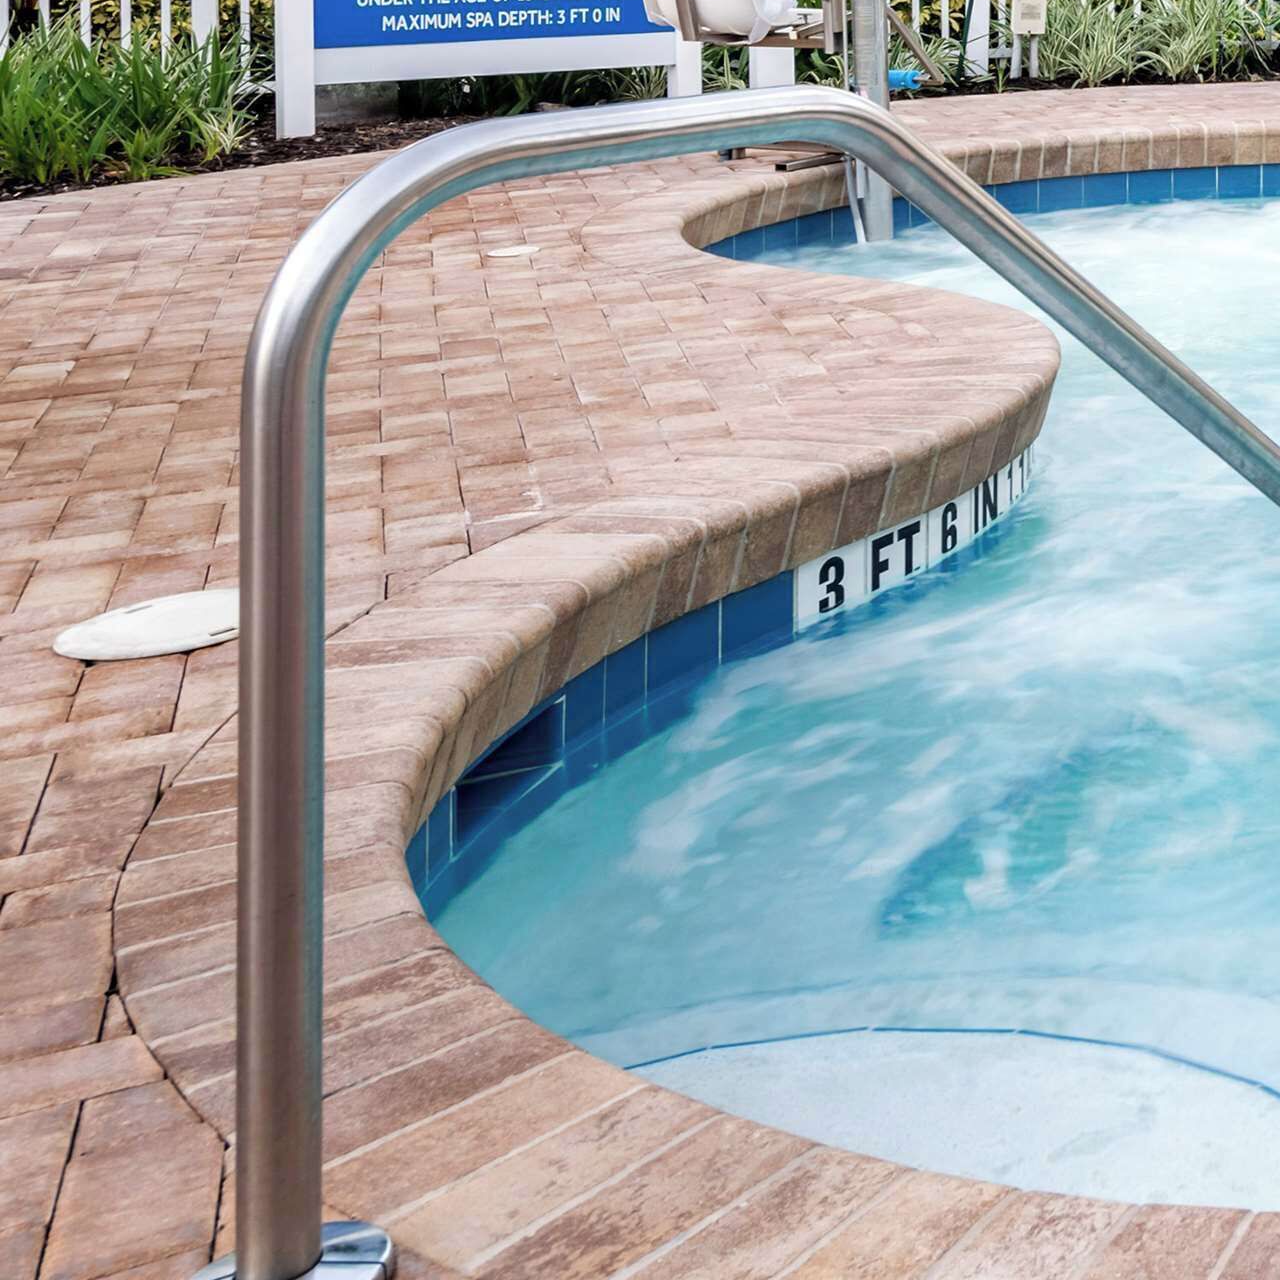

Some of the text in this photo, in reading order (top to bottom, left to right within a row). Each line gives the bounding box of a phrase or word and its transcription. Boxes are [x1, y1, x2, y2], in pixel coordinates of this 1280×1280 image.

[382, 7, 621, 32] MAXIMUM SPA DEPTH: 3 FT 0 IN
[818, 556, 845, 614] 3
[941, 502, 958, 555] 6
